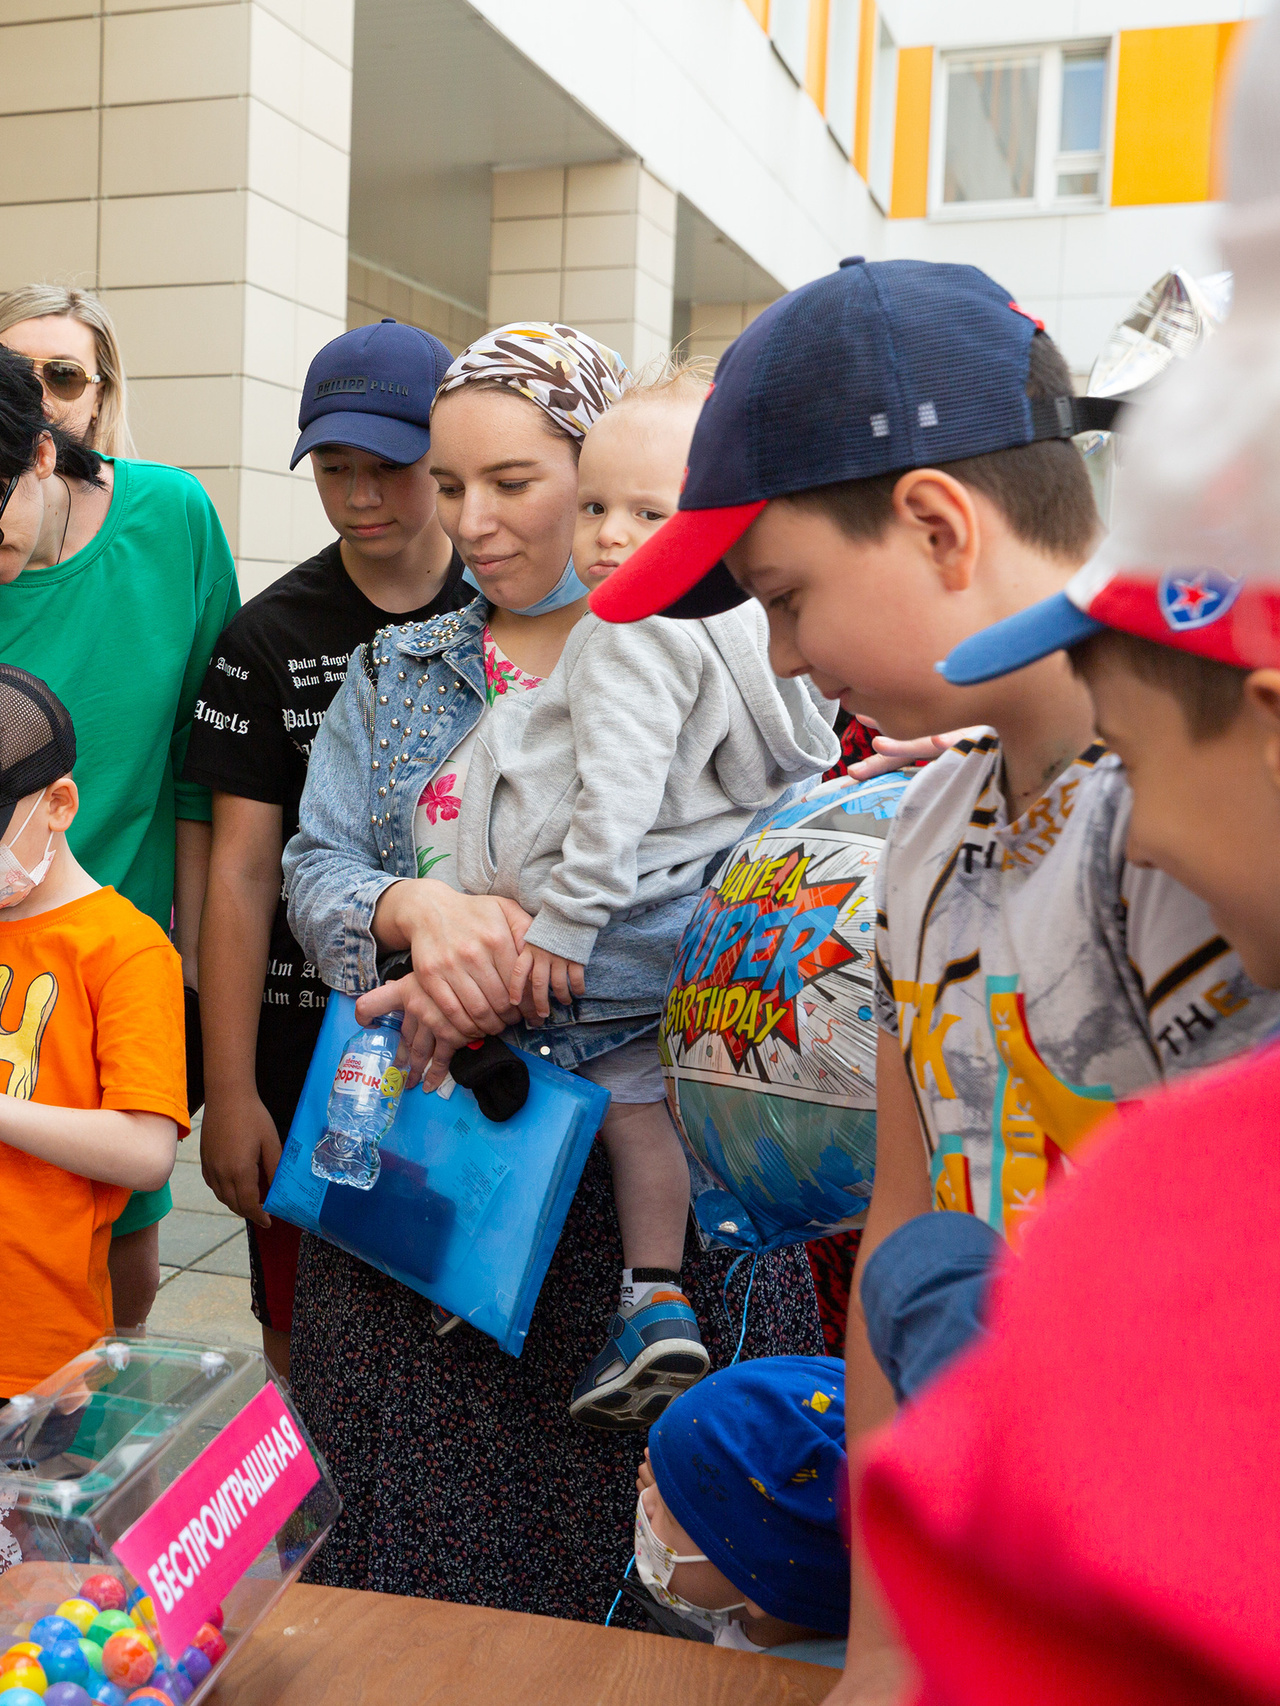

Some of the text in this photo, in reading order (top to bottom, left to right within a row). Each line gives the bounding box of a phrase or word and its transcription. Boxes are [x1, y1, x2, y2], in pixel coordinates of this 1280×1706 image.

[317, 378, 409, 397] PHILIPP PLEIN
[215, 656, 250, 681] Angels
[287, 652, 353, 673] Palm Angel
[292, 671, 348, 689] Palm Ang
[194, 699, 250, 735] Angels
[717, 856, 811, 905] HAVE A
[1156, 980, 1250, 1056] THE
[147, 1414, 303, 1614] БЕСПРОИГРЫШНАЯ
